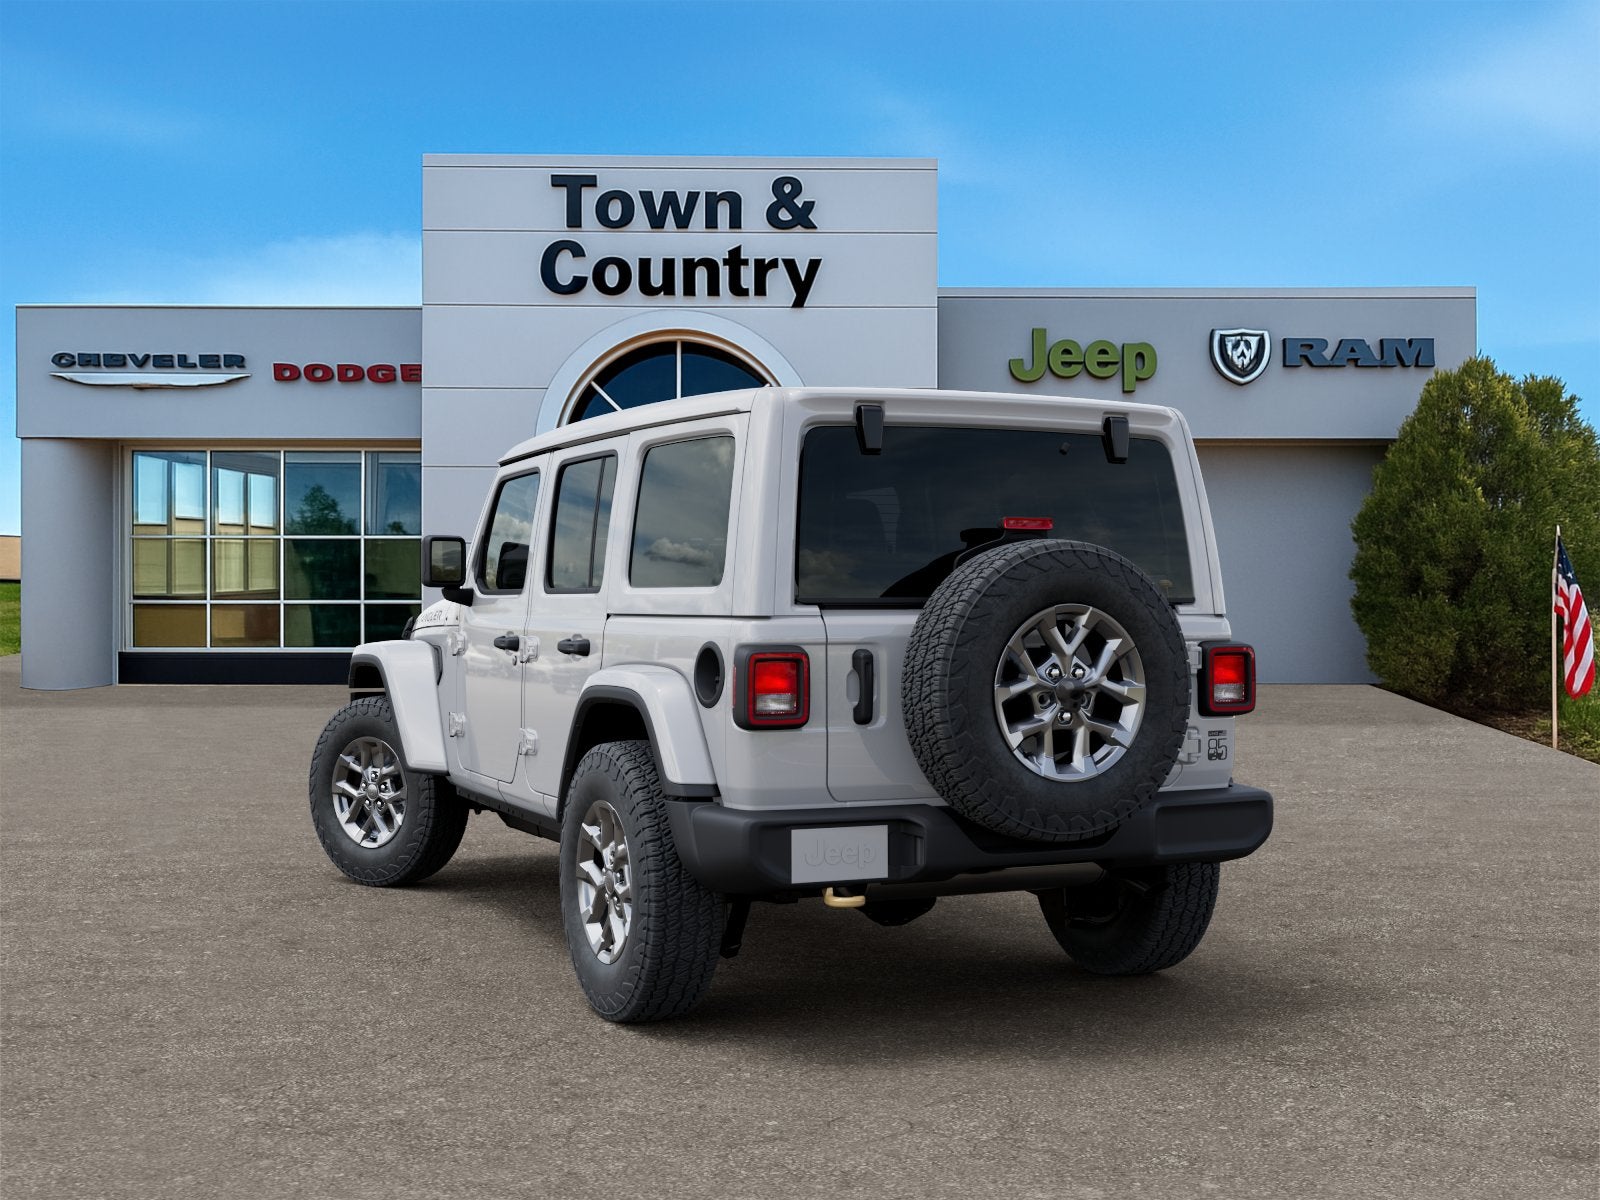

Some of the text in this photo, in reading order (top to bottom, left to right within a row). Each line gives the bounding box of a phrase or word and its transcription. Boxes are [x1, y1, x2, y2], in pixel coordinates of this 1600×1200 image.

[550, 174, 818, 230] Town &
[539, 239, 822, 308] Country
[272, 363, 422, 383] DODGE
[1008, 328, 1157, 392] Jeep
[1282, 337, 1435, 367] RAM
[803, 838, 877, 870] Jeep
